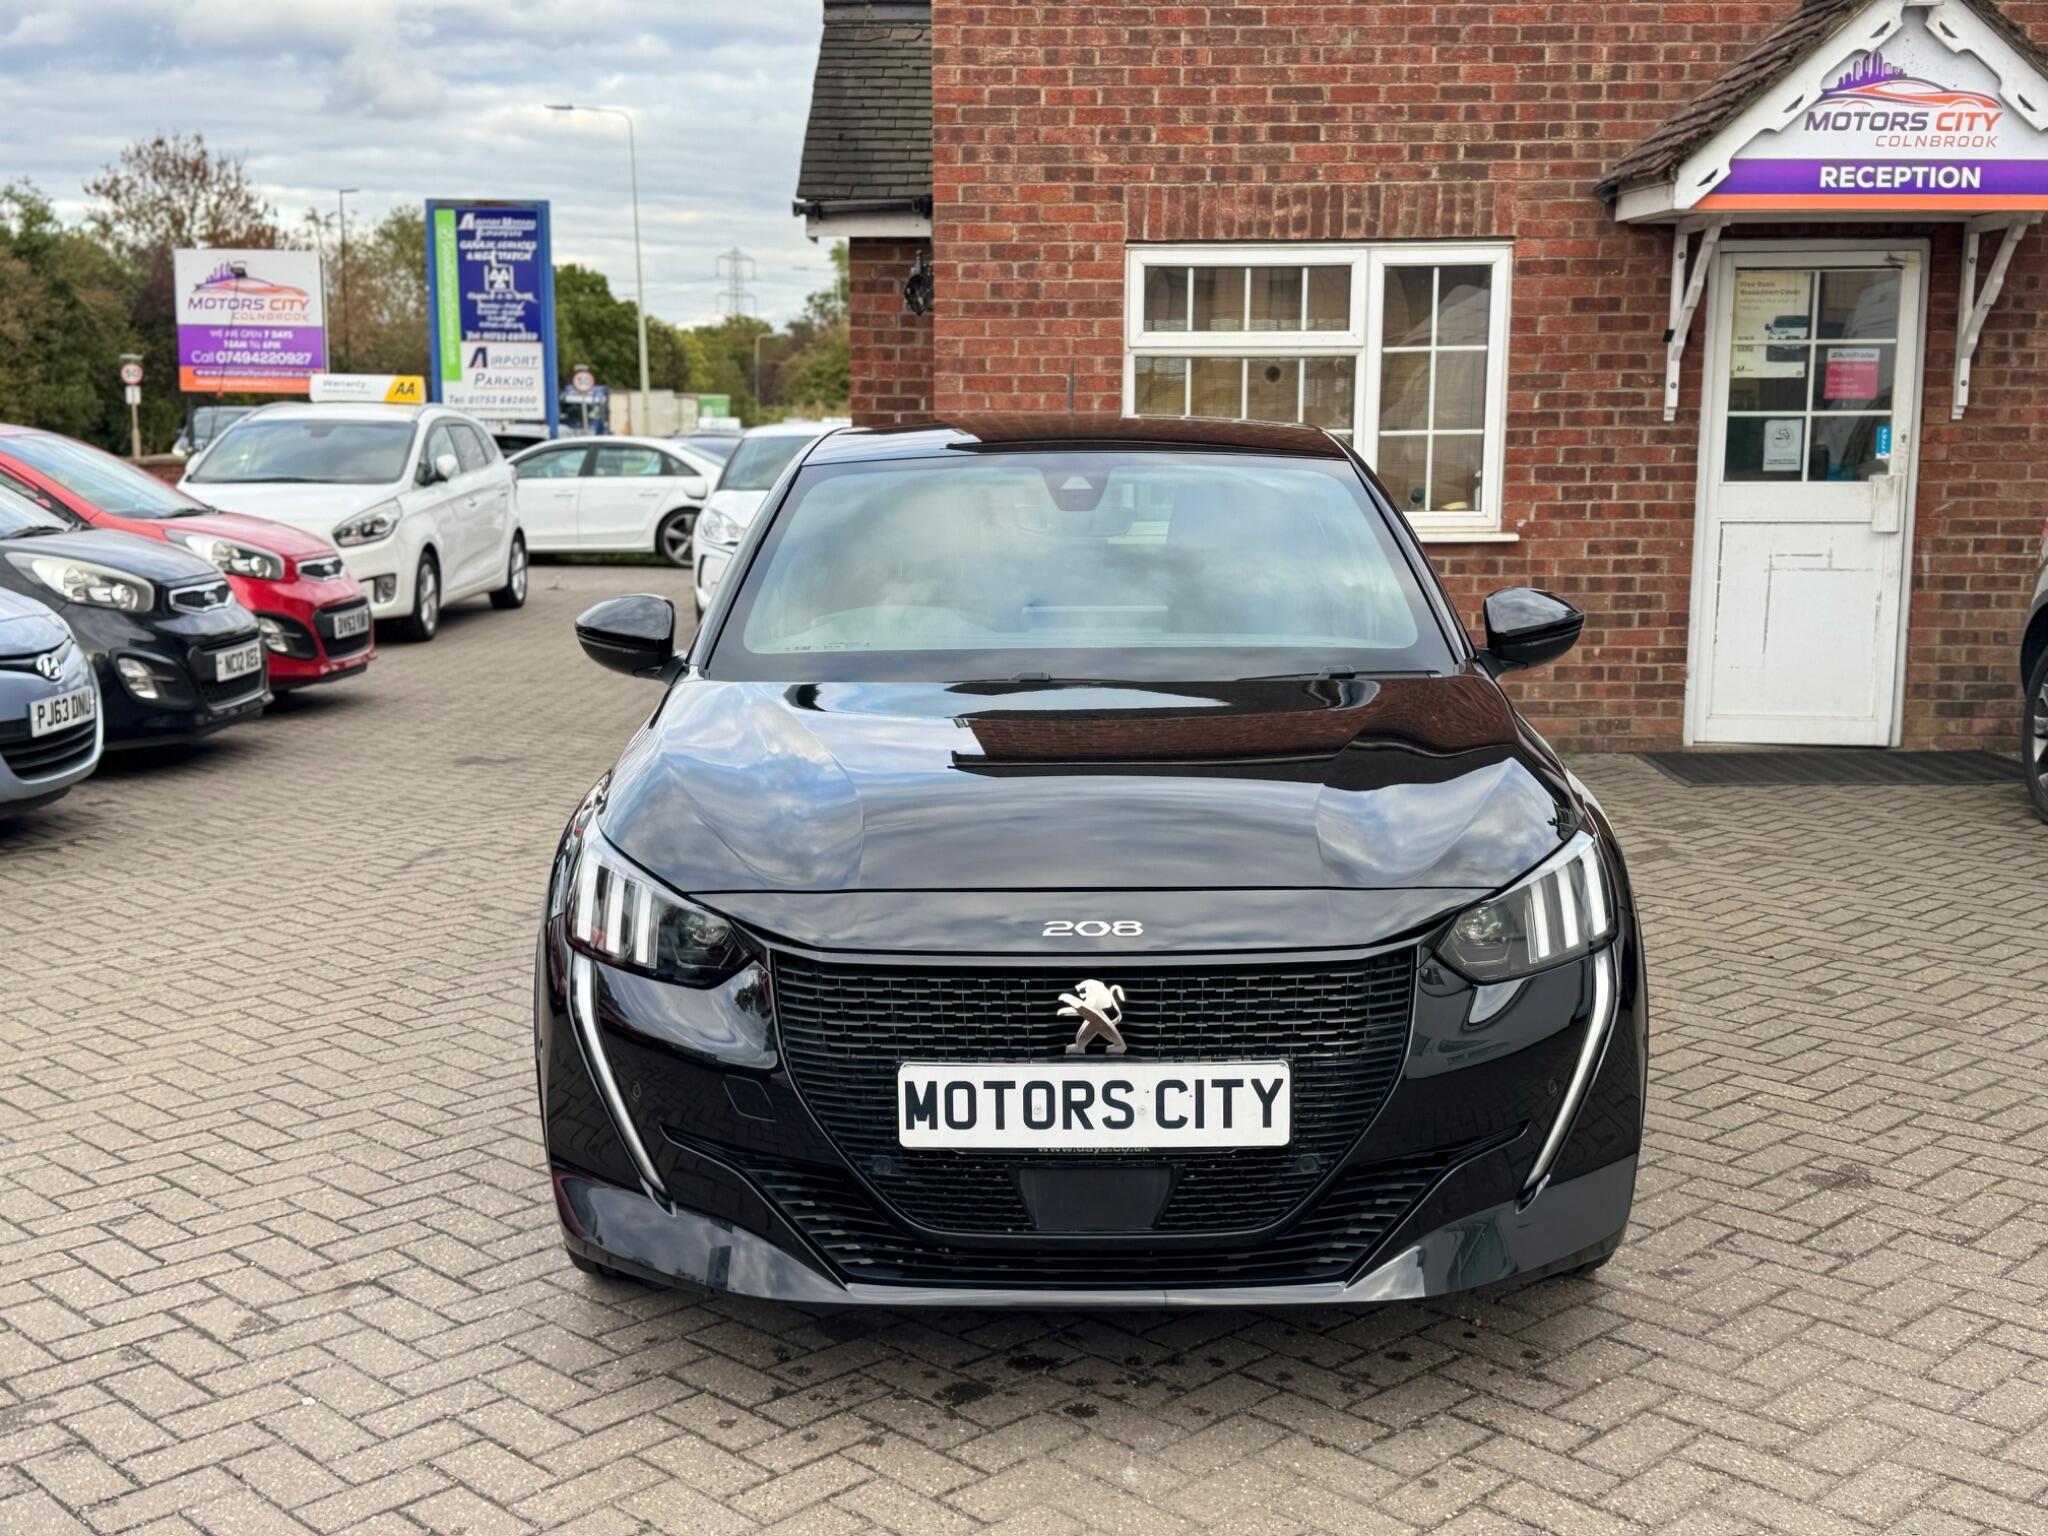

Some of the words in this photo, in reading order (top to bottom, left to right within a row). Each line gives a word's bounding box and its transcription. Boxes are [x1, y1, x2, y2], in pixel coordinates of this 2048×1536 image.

[1804, 112, 1929, 131] MOTORS
[1935, 112, 2002, 131] CITY
[1875, 135, 1998, 148] COLNBROOK
[1820, 166, 1981, 188] RECEPTION
[188, 297, 265, 311] MOTORS
[269, 299, 309, 311] CITY
[232, 312, 309, 321] COLNBROOK
[209, 330, 222, 338] WE
[240, 330, 262, 338] OPEN
[271, 330, 293, 339] DAYS
[191, 350, 214, 363] Call
[215, 351, 312, 365] 07494220927
[469, 347, 538, 368] AIRPORT
[474, 373, 535, 386] PARKING
[323, 380, 367, 389] Warranty
[395, 382, 416, 395] AA
[37, 697, 70, 730] PJ63
[1042, 920, 1144, 937] 208
[904, 1080, 1135, 1131] MOTORS
[1155, 1078, 1284, 1131] CITY
